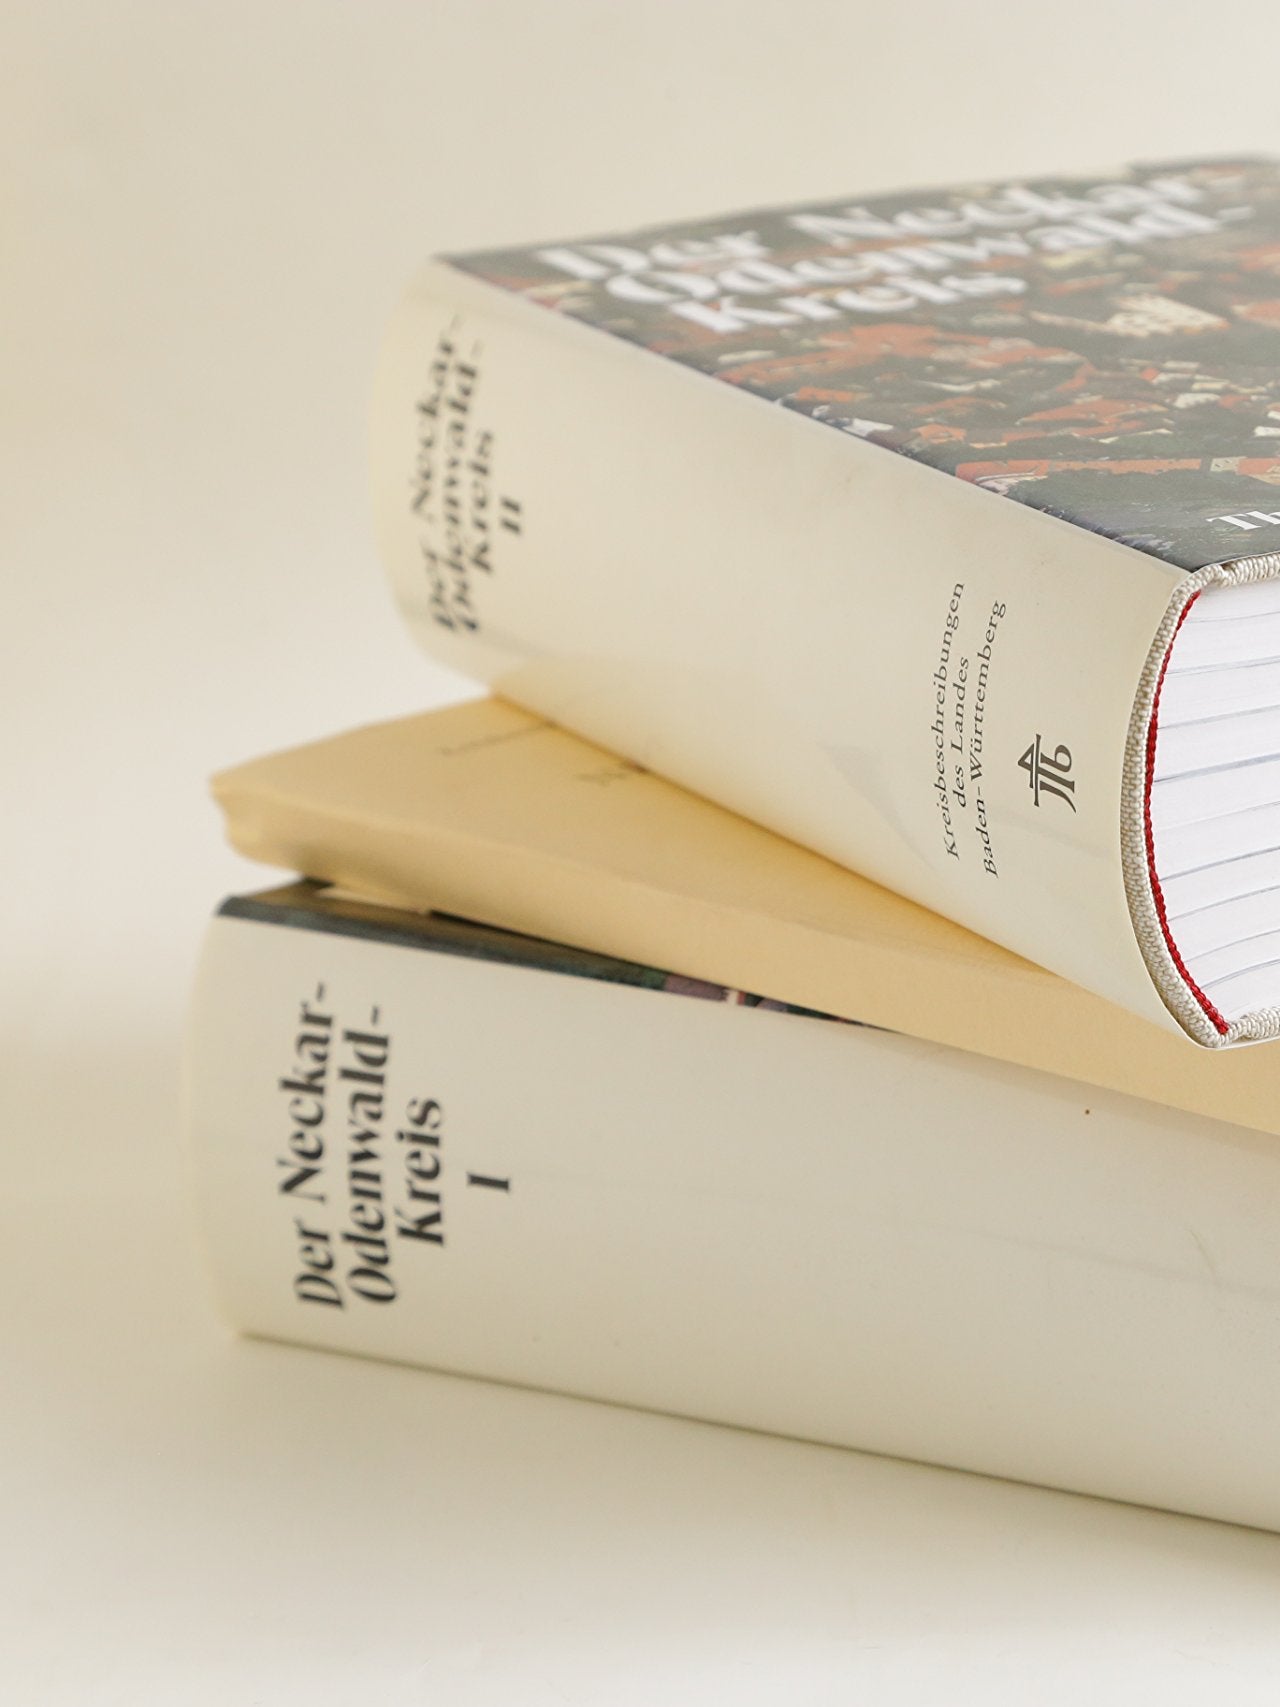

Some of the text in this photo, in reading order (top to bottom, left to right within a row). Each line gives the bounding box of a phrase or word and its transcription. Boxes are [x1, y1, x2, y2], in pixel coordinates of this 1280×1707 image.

[537, 231, 768, 280] Der
[668, 271, 1026, 332] Kreis
[468, 426, 494, 575] Kreis
[499, 494, 523, 536] II
[931, 582, 966, 860] Kreisbeschreibungen
[950, 656, 970, 808] des Landes
[277, 982, 346, 1312] Der Neckar-
[338, 1004, 397, 1306] Odenwald-
[395, 1097, 446, 1248] Kreis
[466, 1171, 511, 1193] I
